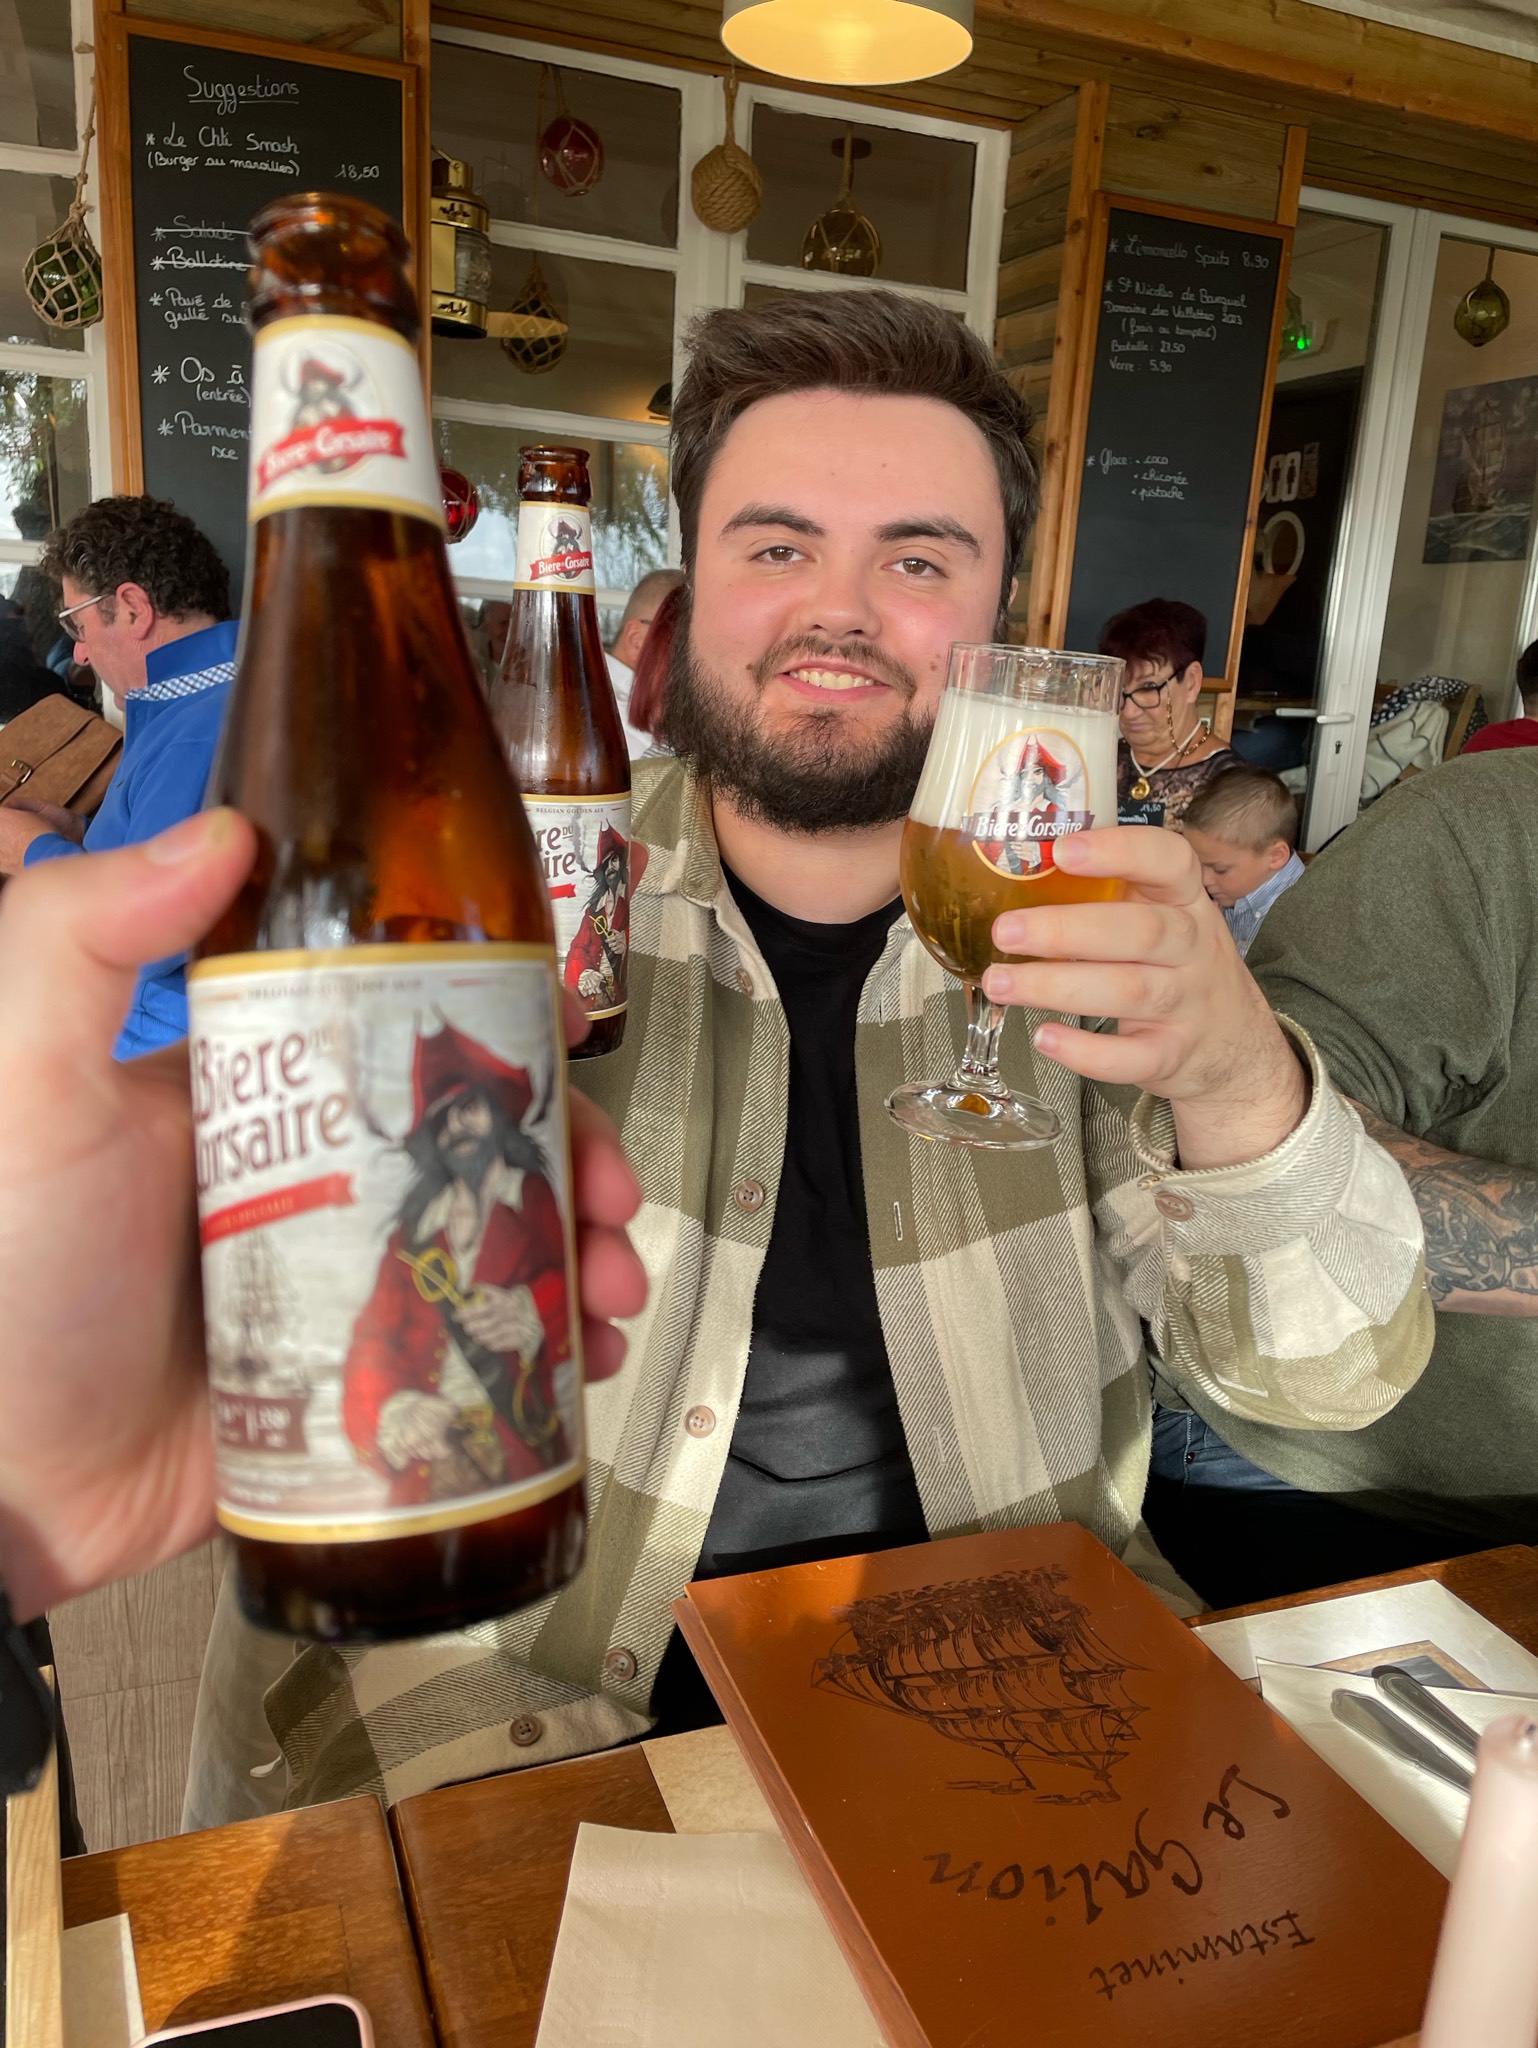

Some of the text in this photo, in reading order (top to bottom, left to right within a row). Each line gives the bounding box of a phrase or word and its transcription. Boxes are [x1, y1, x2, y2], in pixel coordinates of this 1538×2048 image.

[183, 64, 300, 115] Suggestions
[163, 121, 187, 148] Le
[246, 132, 300, 155] Smash
[148, 151, 300, 177] (Burger au maroilles)
[335, 164, 380, 182] 18,50
[1242, 251, 1270, 270] 8.90
[165, 286, 206, 307] Pavé
[212, 292, 233, 309] de
[1181, 287, 1196, 302] de
[164, 307, 210, 330] grillé
[180, 356, 216, 384] Os
[196, 383, 252, 409] (entrée)
[562, 826, 574, 836] DU
[1027, 814, 1084, 837] Corsaire
[198, 1092, 356, 1189] orsaire
[923, 1764, 1291, 1928] Le Galion
[1089, 1909, 1316, 2001] Estaminet
